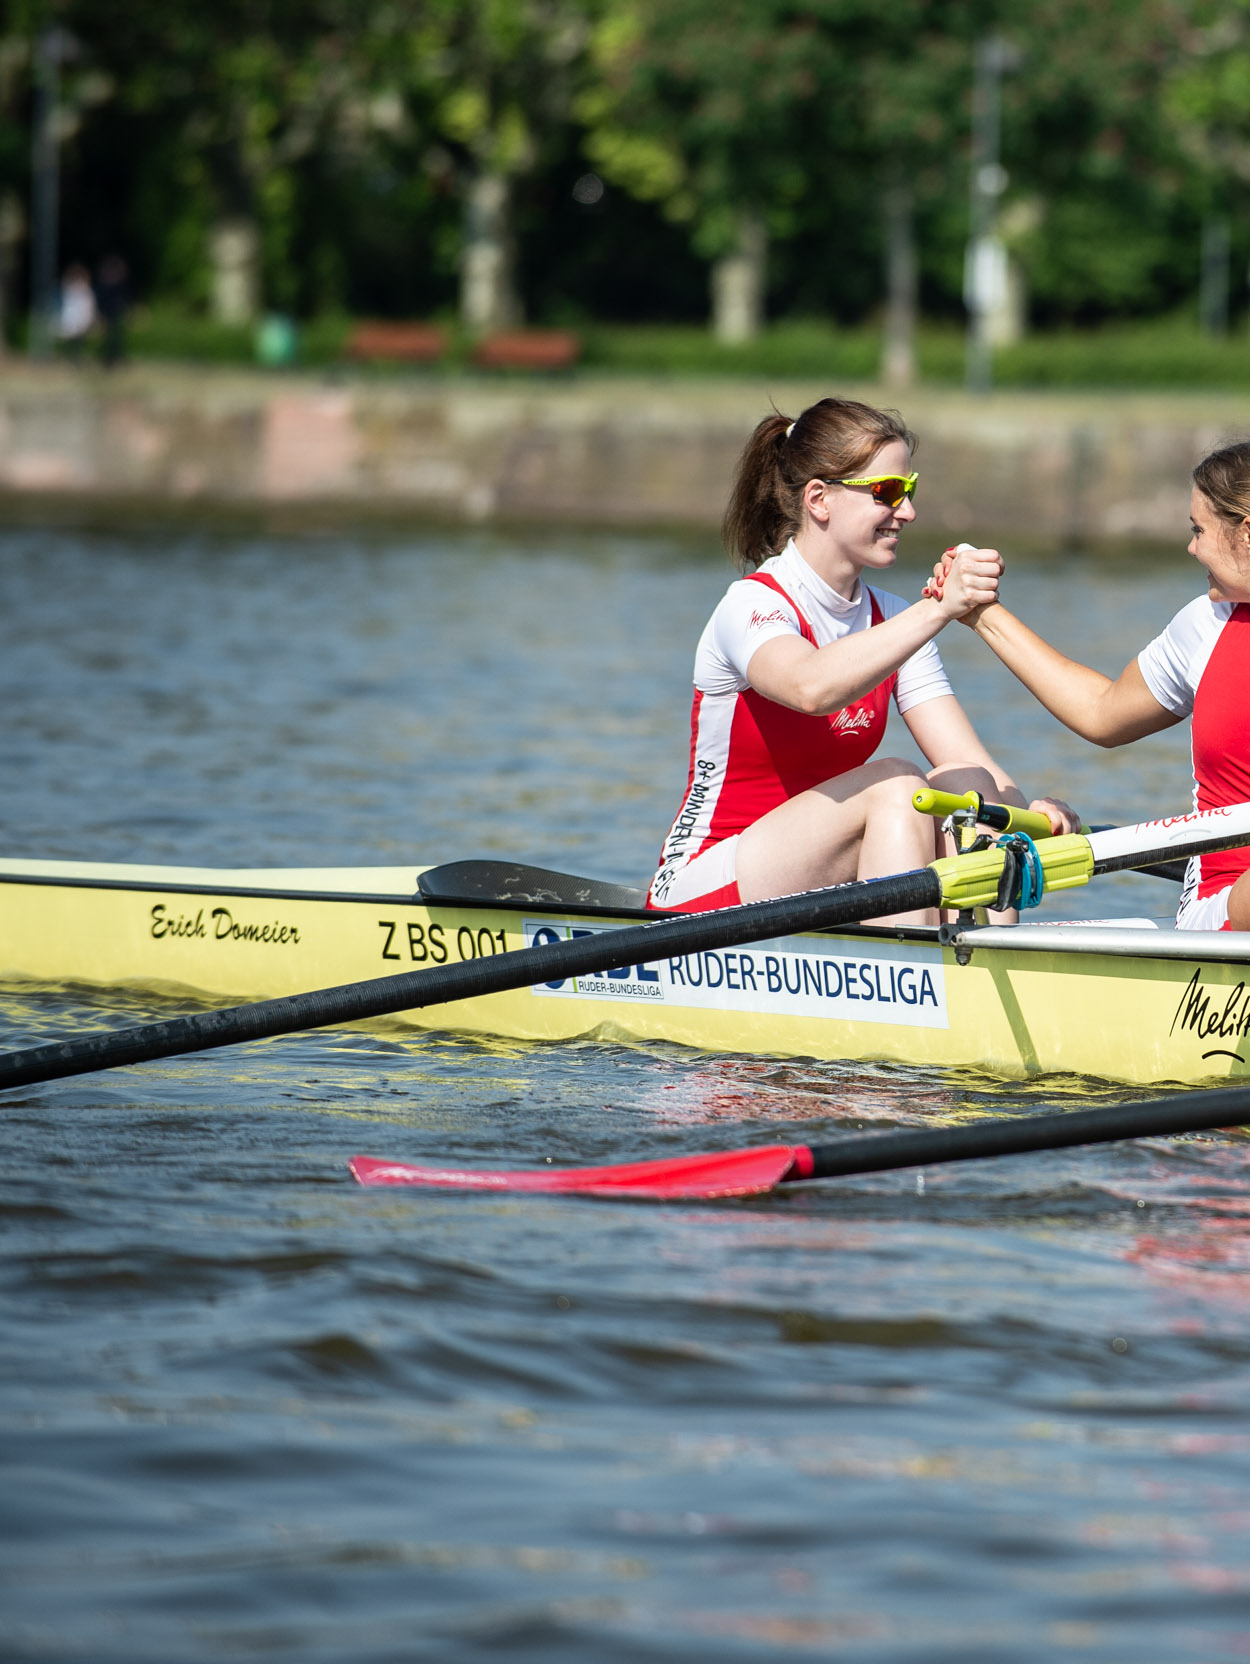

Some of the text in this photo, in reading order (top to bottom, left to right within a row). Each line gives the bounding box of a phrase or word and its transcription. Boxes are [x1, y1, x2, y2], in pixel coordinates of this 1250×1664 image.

[829, 707, 871, 730] Melitta
[151, 904, 301, 944] Erich Domeier
[378, 921, 507, 964] Z BS 001
[578, 980, 662, 997] RUDER-BUNDESLIGA
[670, 952, 939, 1007] RUDER-BUNDESLIGA
